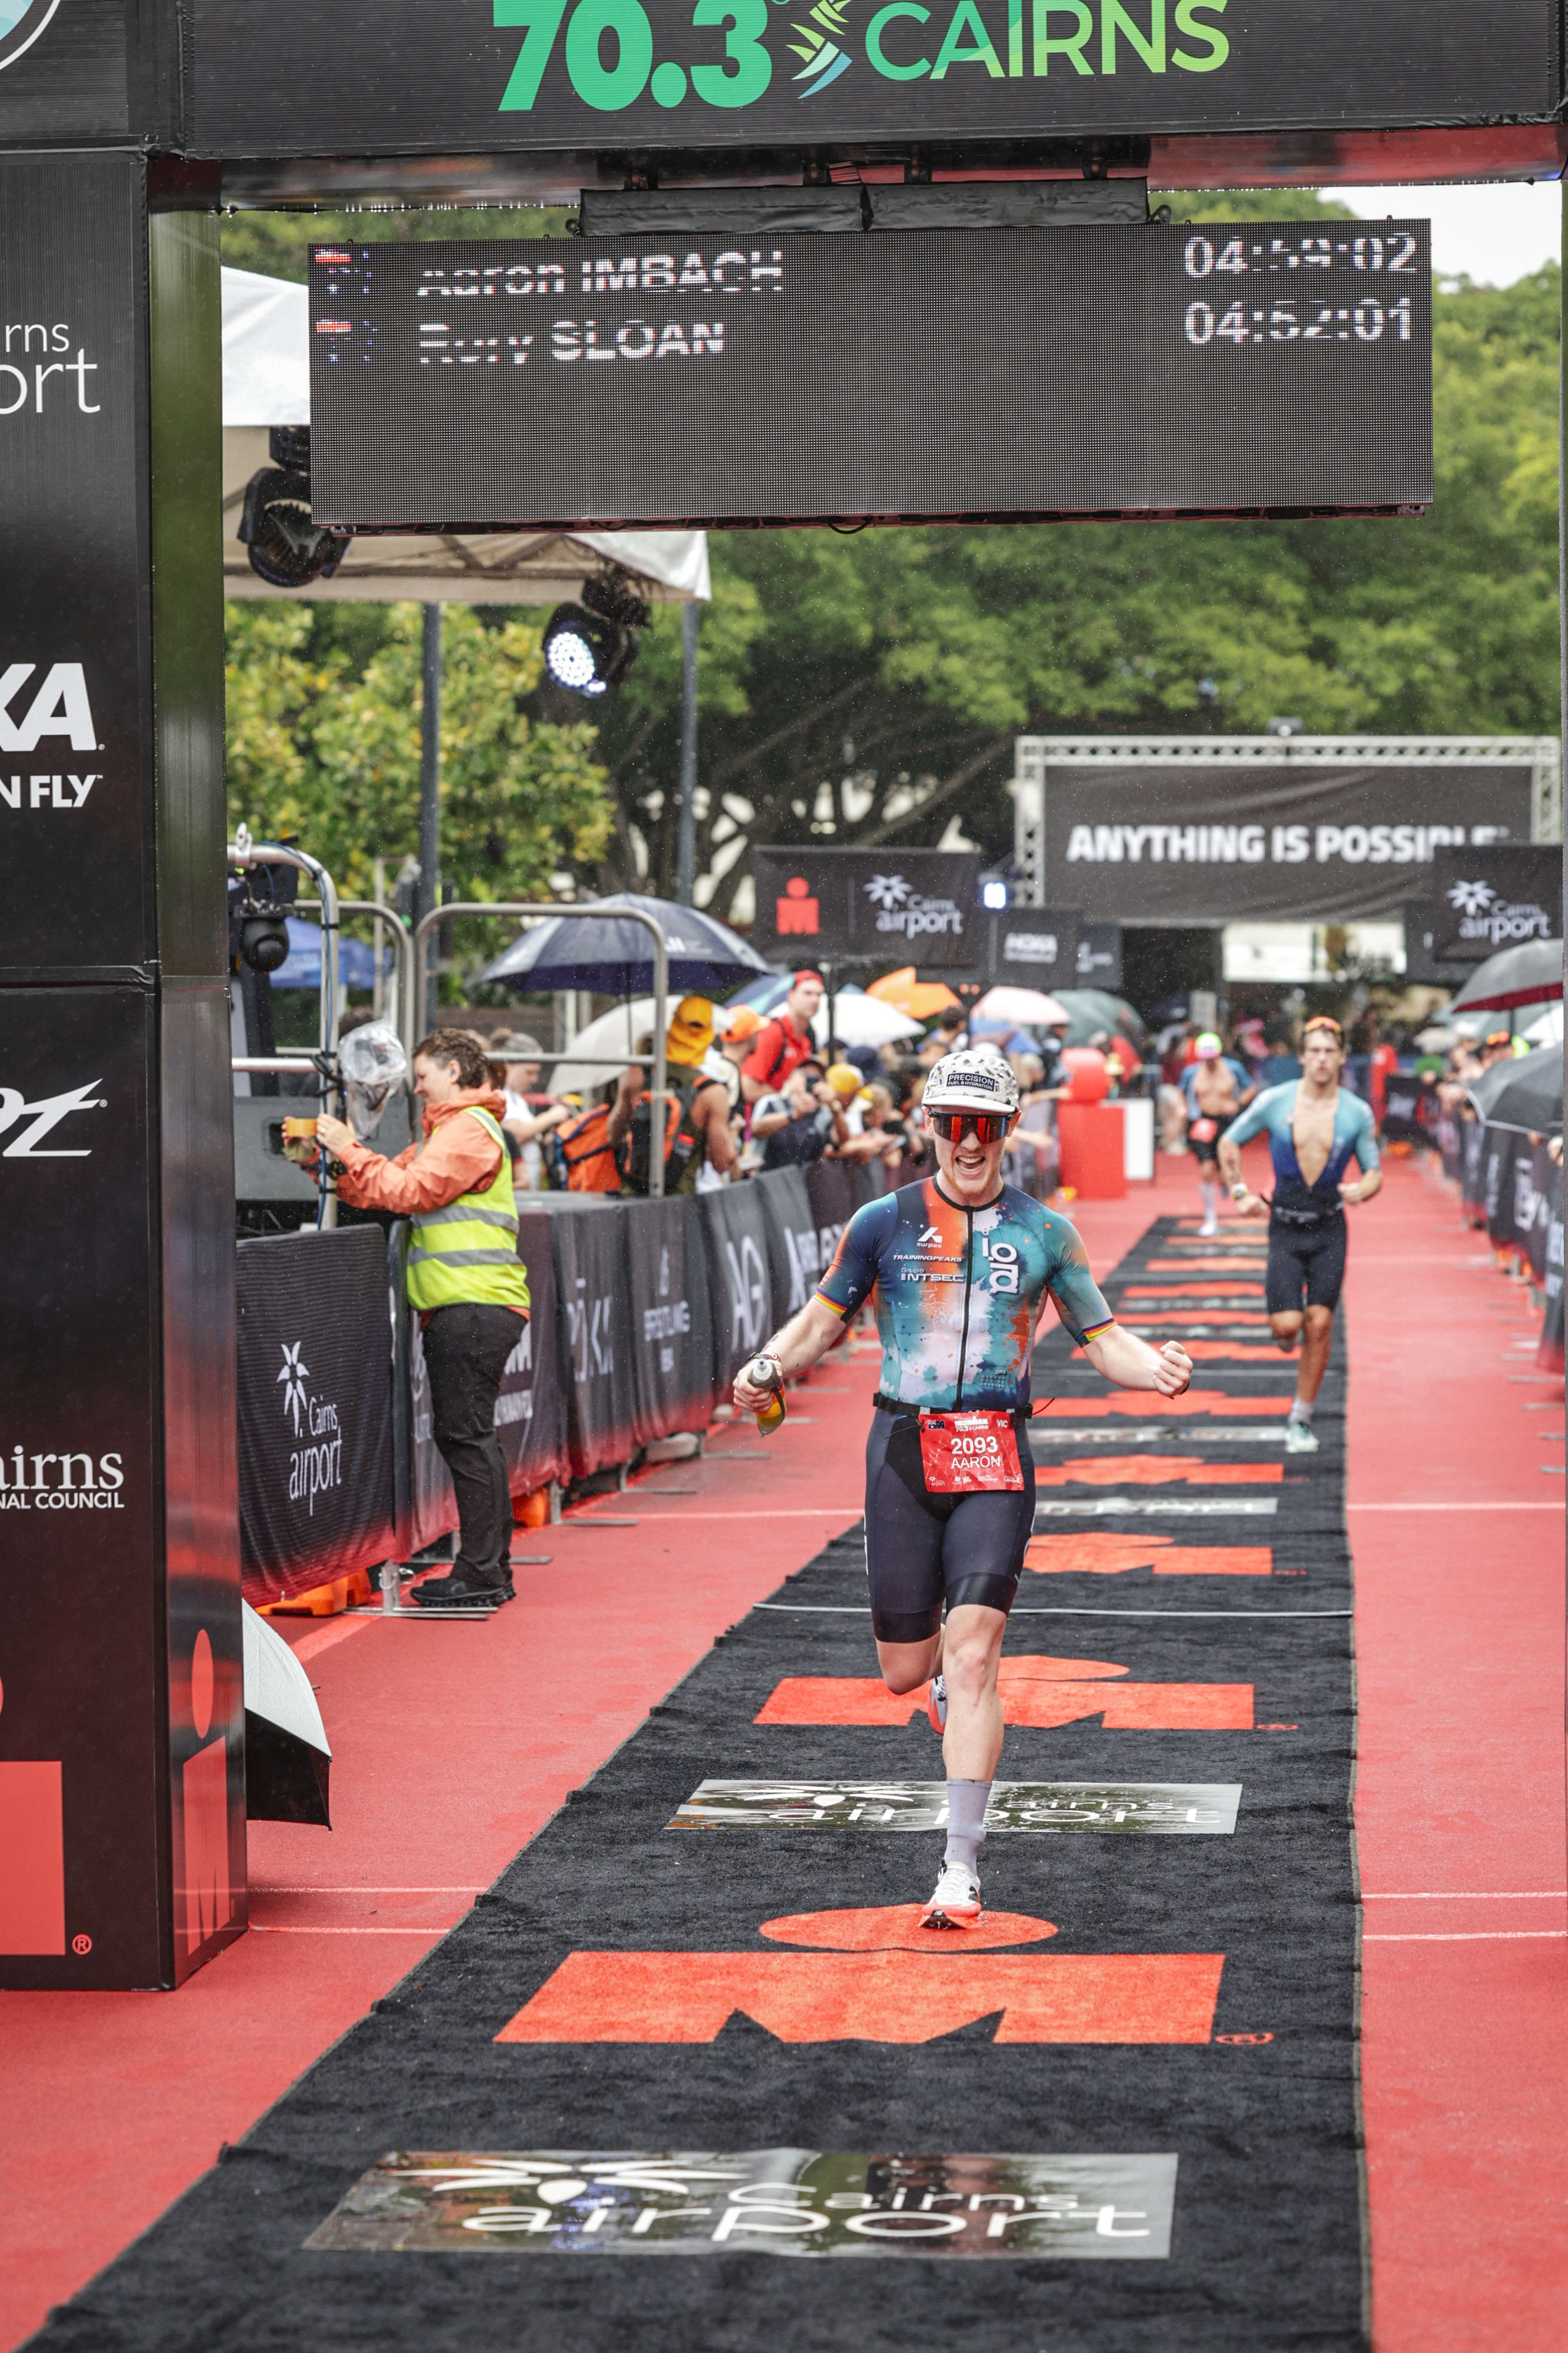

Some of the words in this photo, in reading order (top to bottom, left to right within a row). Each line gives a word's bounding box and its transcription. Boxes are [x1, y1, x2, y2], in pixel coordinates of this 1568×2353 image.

[865, 0, 1229, 81] CAIRNS
[582, 251, 783, 292] IMBACH
[552, 319, 725, 360] SLOAN
[29, 775, 98, 808] FLY
[1066, 824, 1266, 862] ANYTHING
[1272, 824, 1310, 862] IS
[876, 906, 965, 939] airport
[1459, 911, 1552, 945] airport
[949, 1074, 993, 1086] PRECISION
[965, 1082, 993, 1090] HYDRATION
[309, 1395, 338, 1436] Cairns
[997, 1419, 1007, 1428] VIC
[950, 1435, 998, 1454] 2093
[289, 1426, 342, 1517] airport
[950, 1455, 1000, 1469] AARON
[35, 1492, 125, 1509] COUNCIL
[726, 2181, 1079, 2212] Cairns
[461, 2197, 1153, 2242] airport
